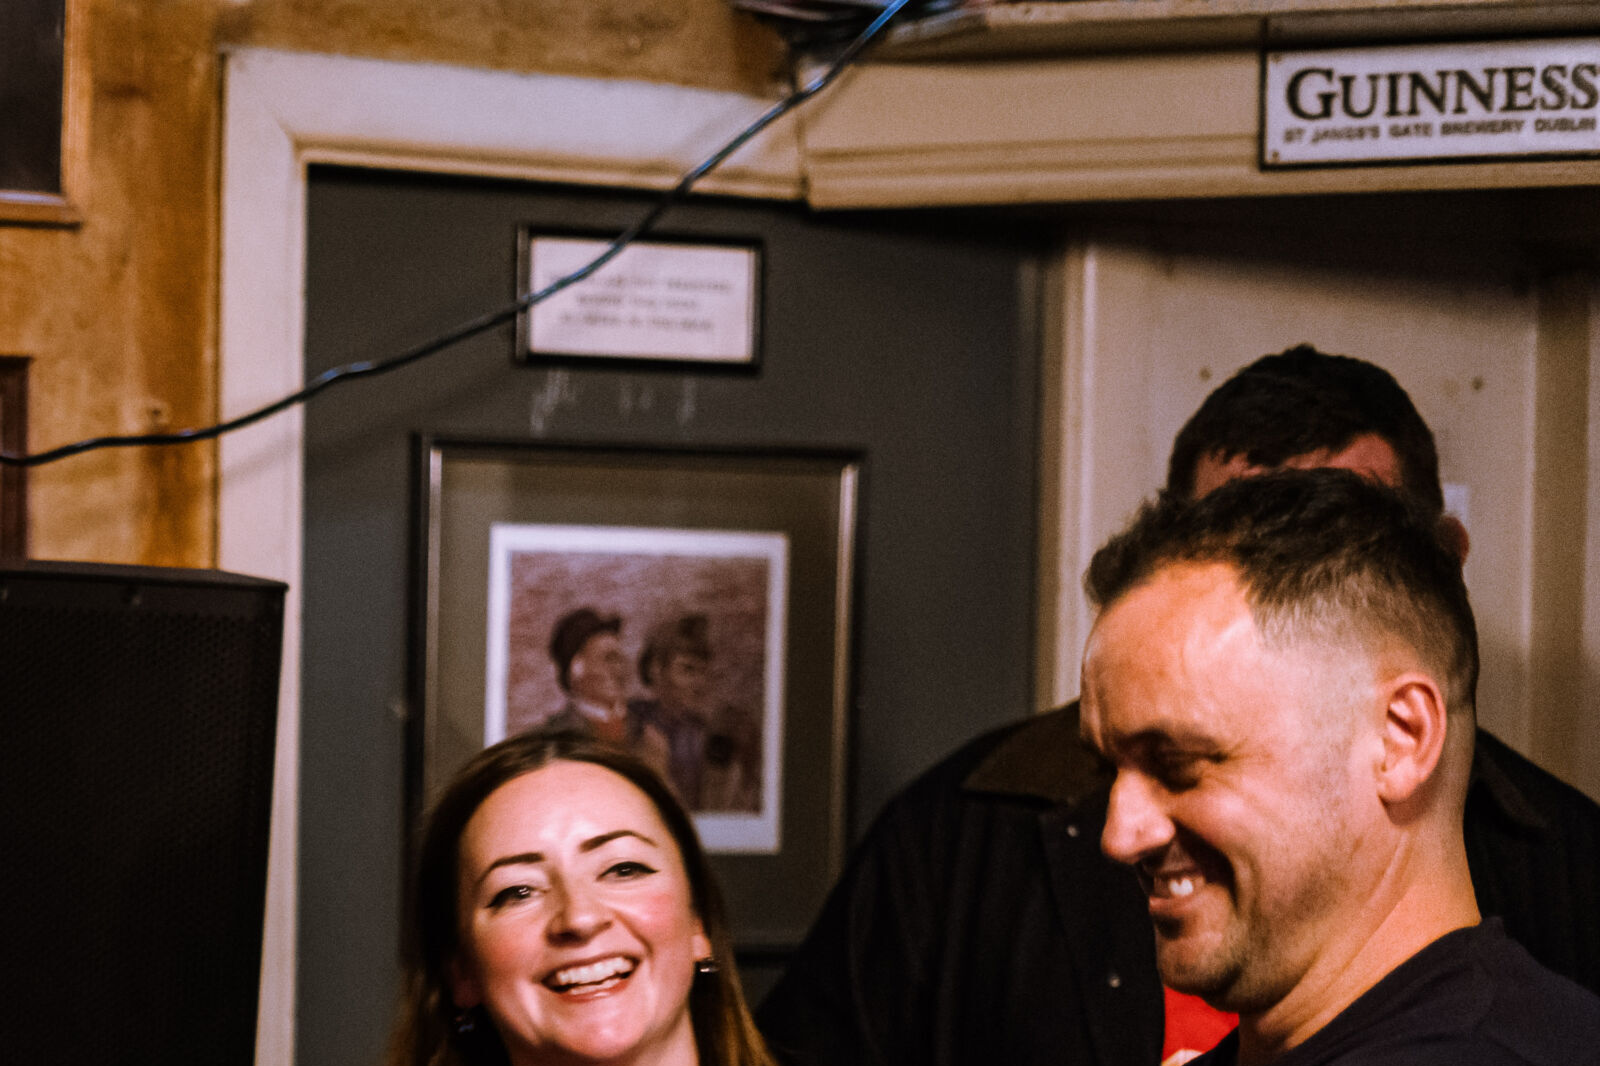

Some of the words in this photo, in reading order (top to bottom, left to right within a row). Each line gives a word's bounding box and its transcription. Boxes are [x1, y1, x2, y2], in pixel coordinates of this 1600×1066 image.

[1286, 63, 1599, 121] GUINNESS
[1388, 121, 1434, 139] GATE
[1534, 116, 1597, 134] DUBLIN
